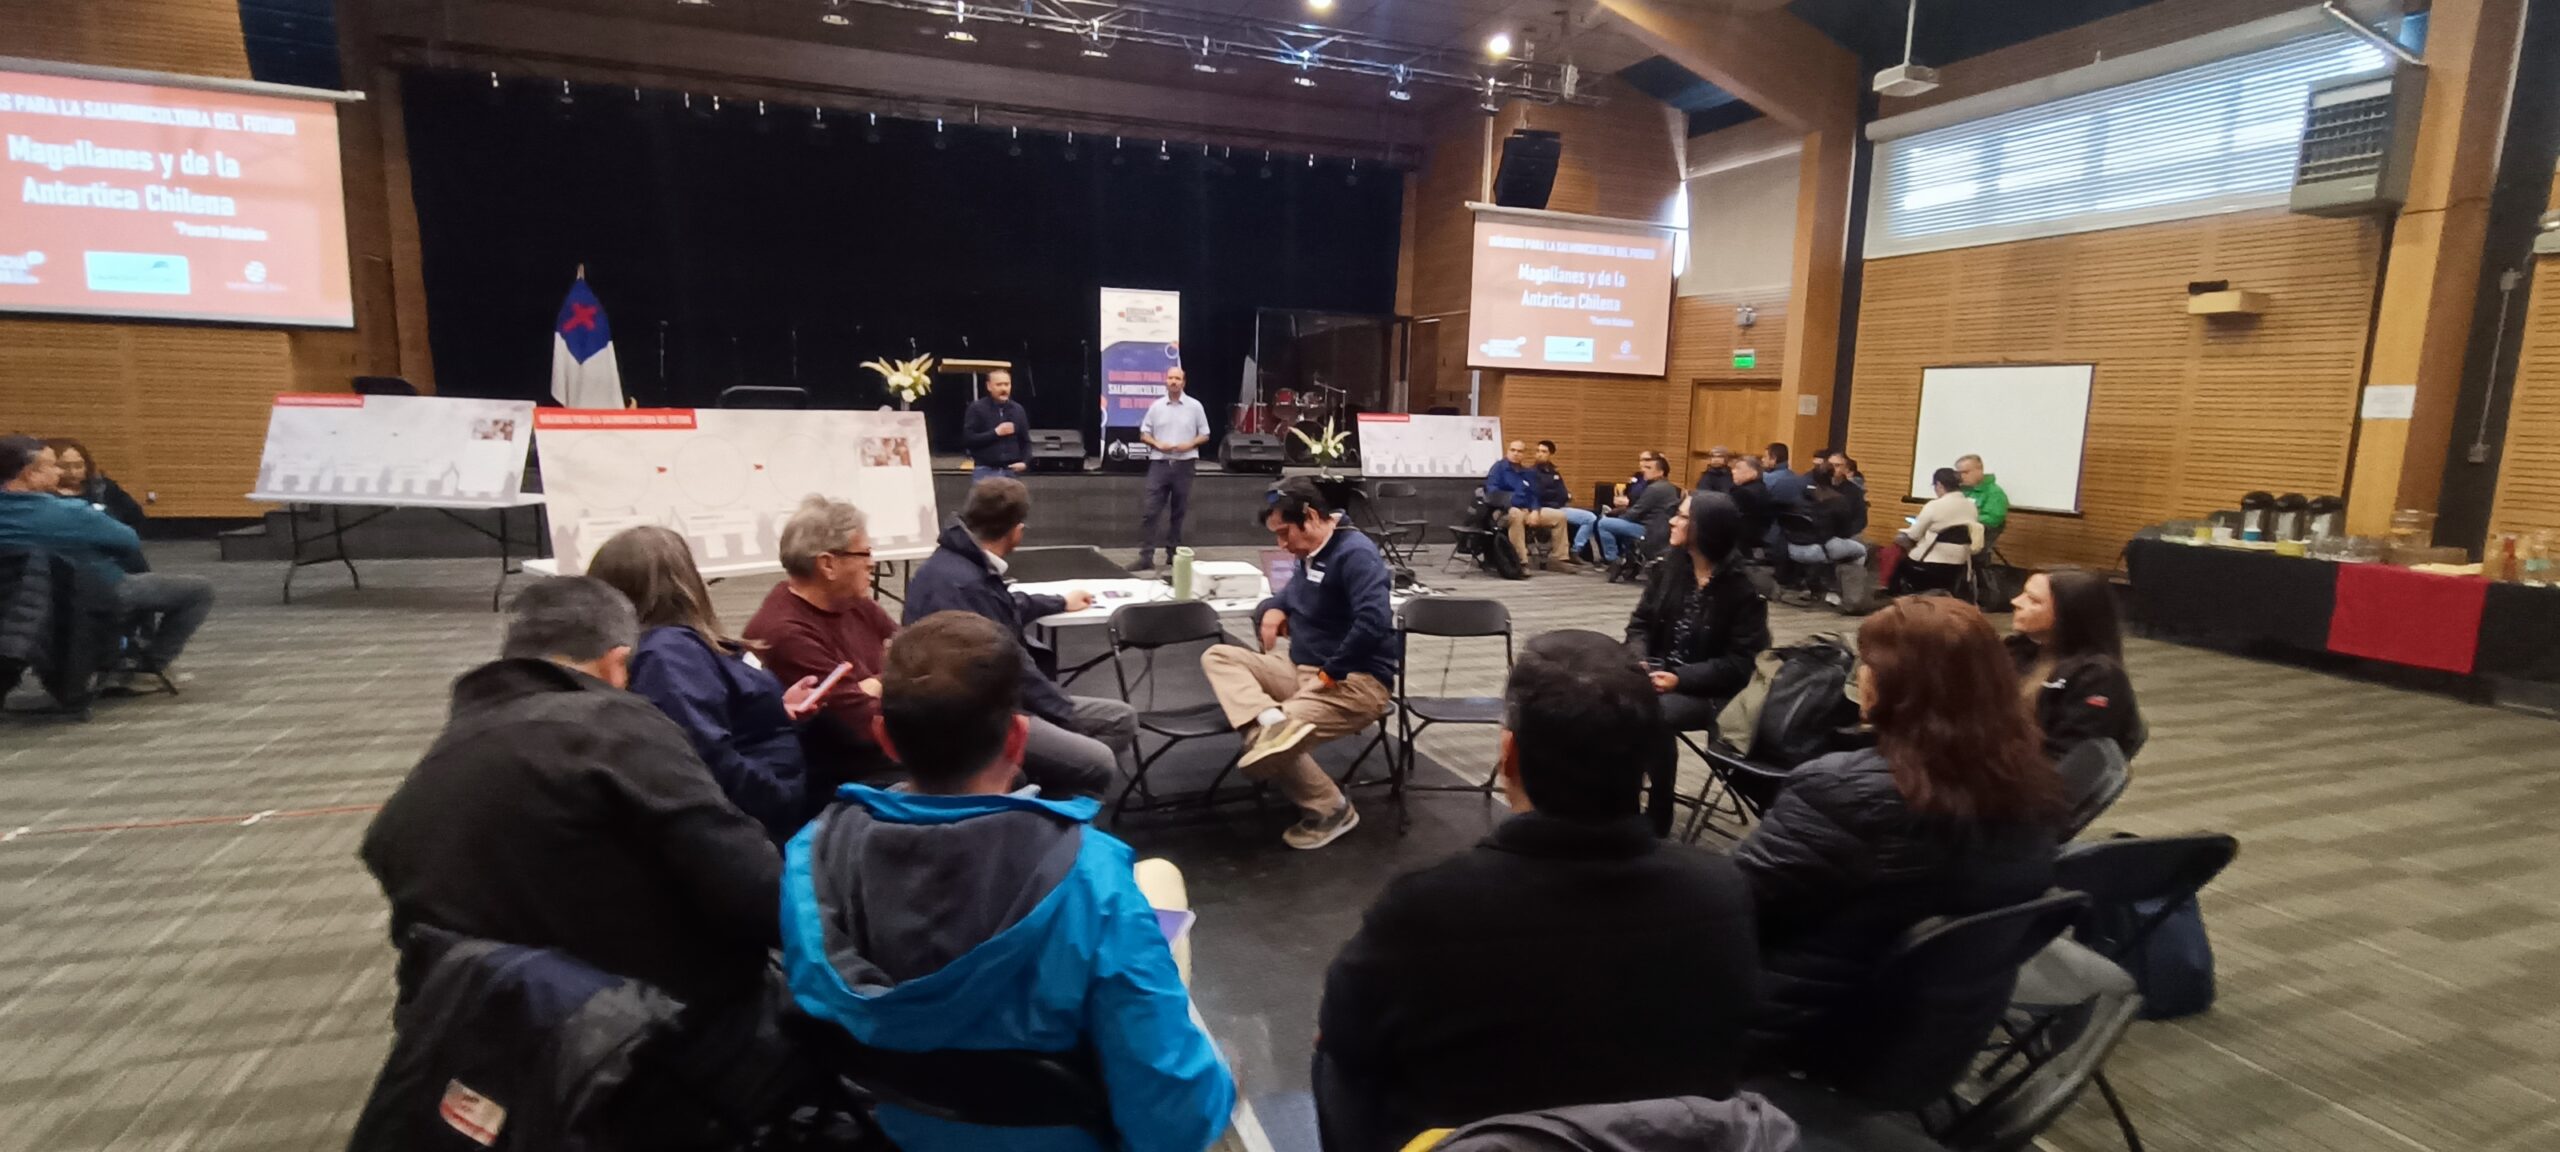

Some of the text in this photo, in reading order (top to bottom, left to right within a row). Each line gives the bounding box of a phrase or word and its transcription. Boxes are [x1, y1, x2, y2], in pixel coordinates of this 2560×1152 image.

[15, 94, 58, 115] PARA
[60, 99, 82, 116] LA
[213, 112, 241, 131] DEL
[7, 134, 241, 179] Magallanes y de la
[23, 176, 237, 216] Antartica Chilena
[1518, 263, 1627, 288] Magallanes y de la
[1578, 291, 1621, 311] Chilena
